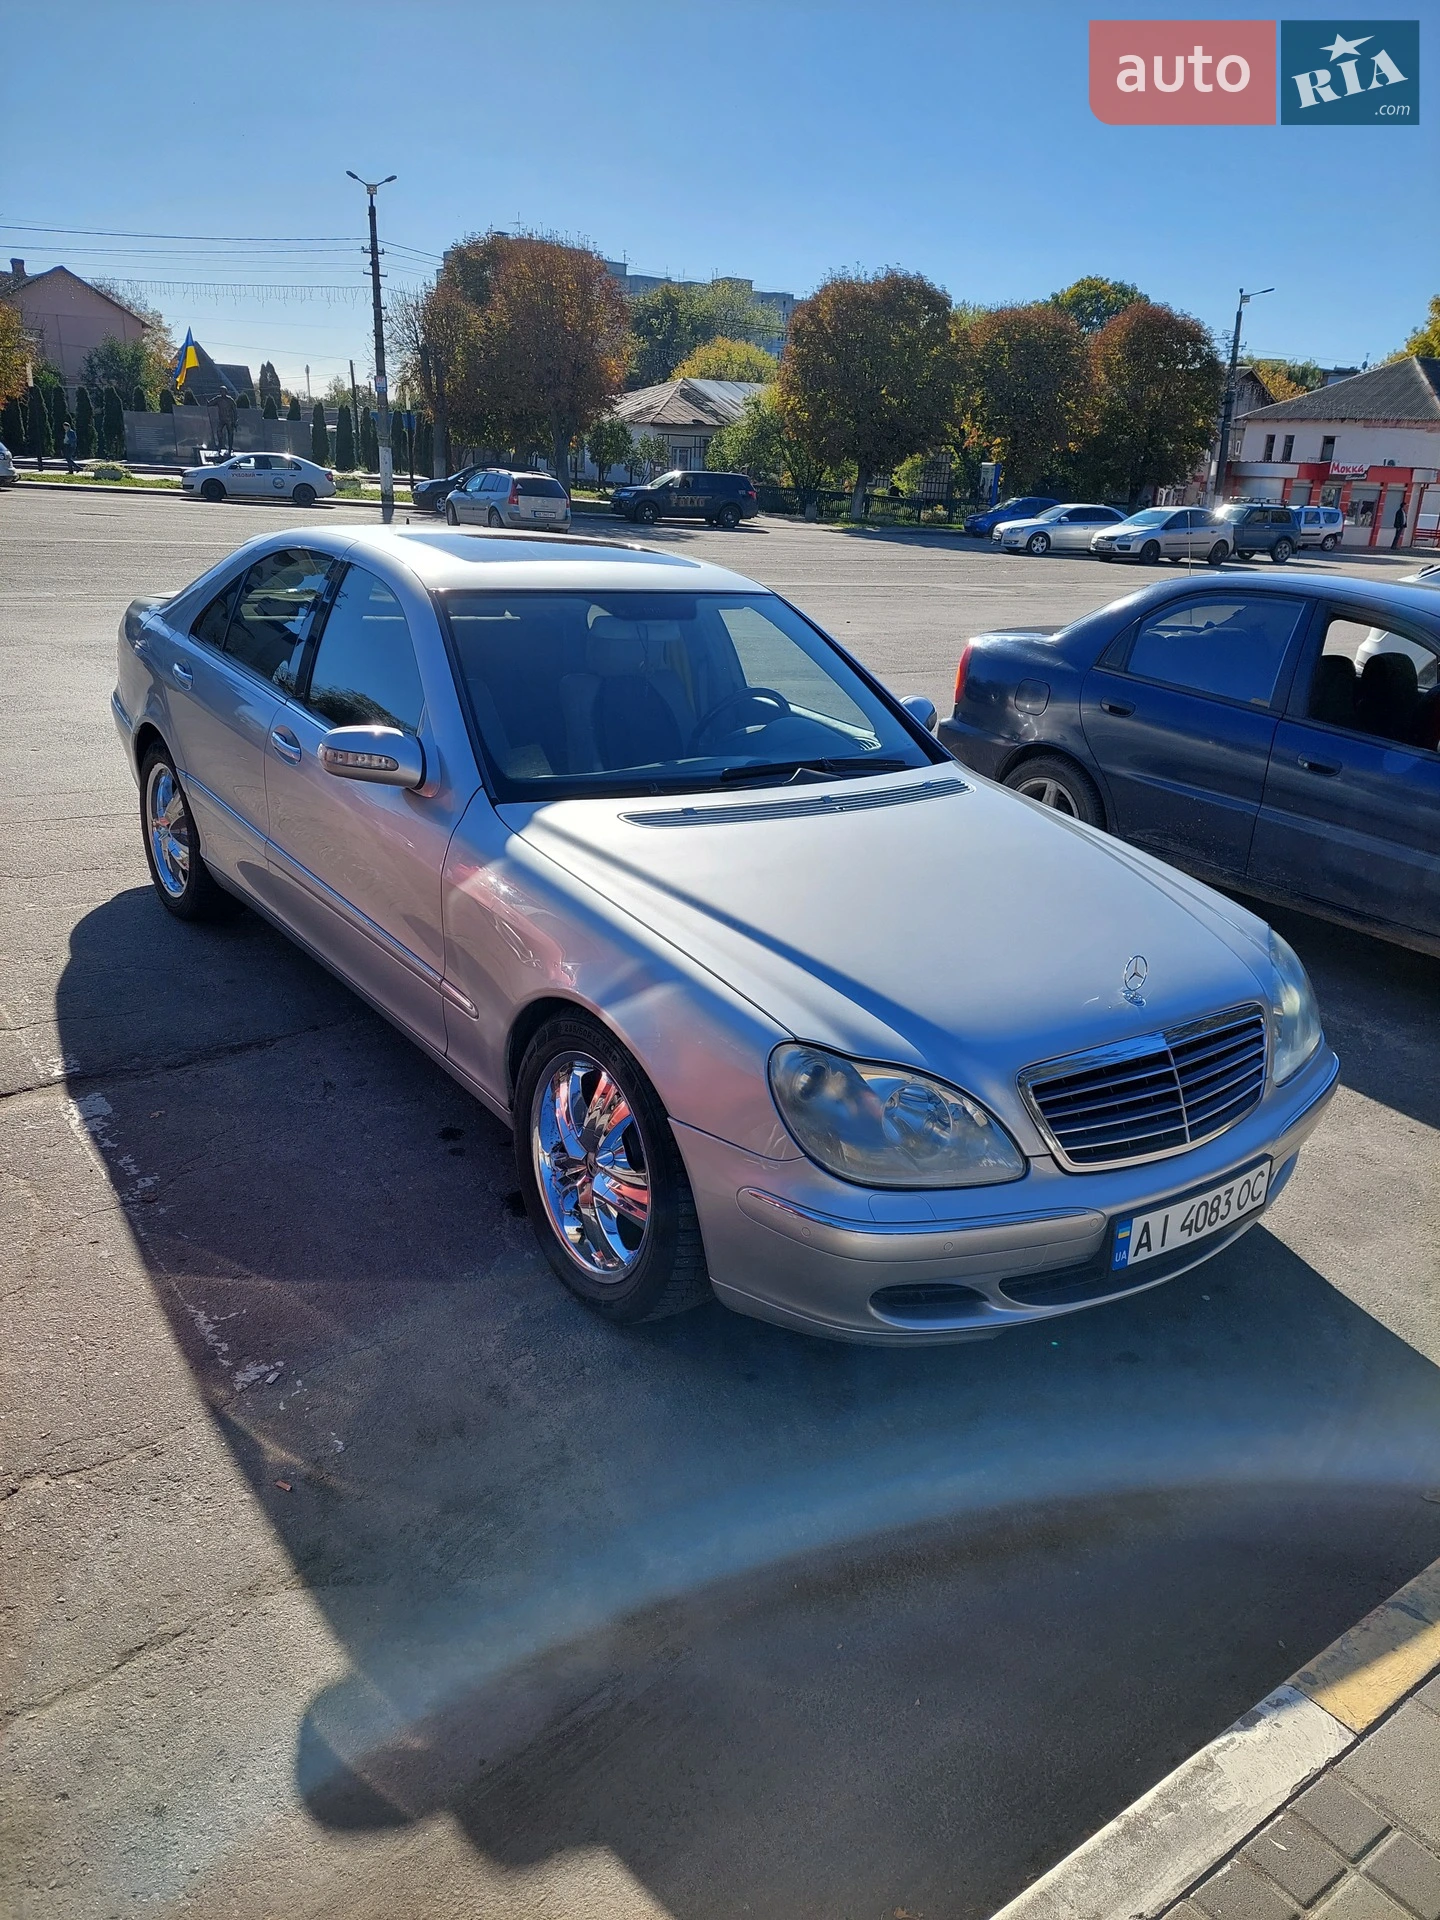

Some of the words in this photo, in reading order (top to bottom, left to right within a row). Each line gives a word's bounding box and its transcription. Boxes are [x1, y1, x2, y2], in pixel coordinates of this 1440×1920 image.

[1133, 1214, 1170, 1257] AI
[1180, 1186, 1234, 1238] 4083
[1236, 1170, 1265, 1211] OC
[1114, 1249, 1127, 1263] UA
